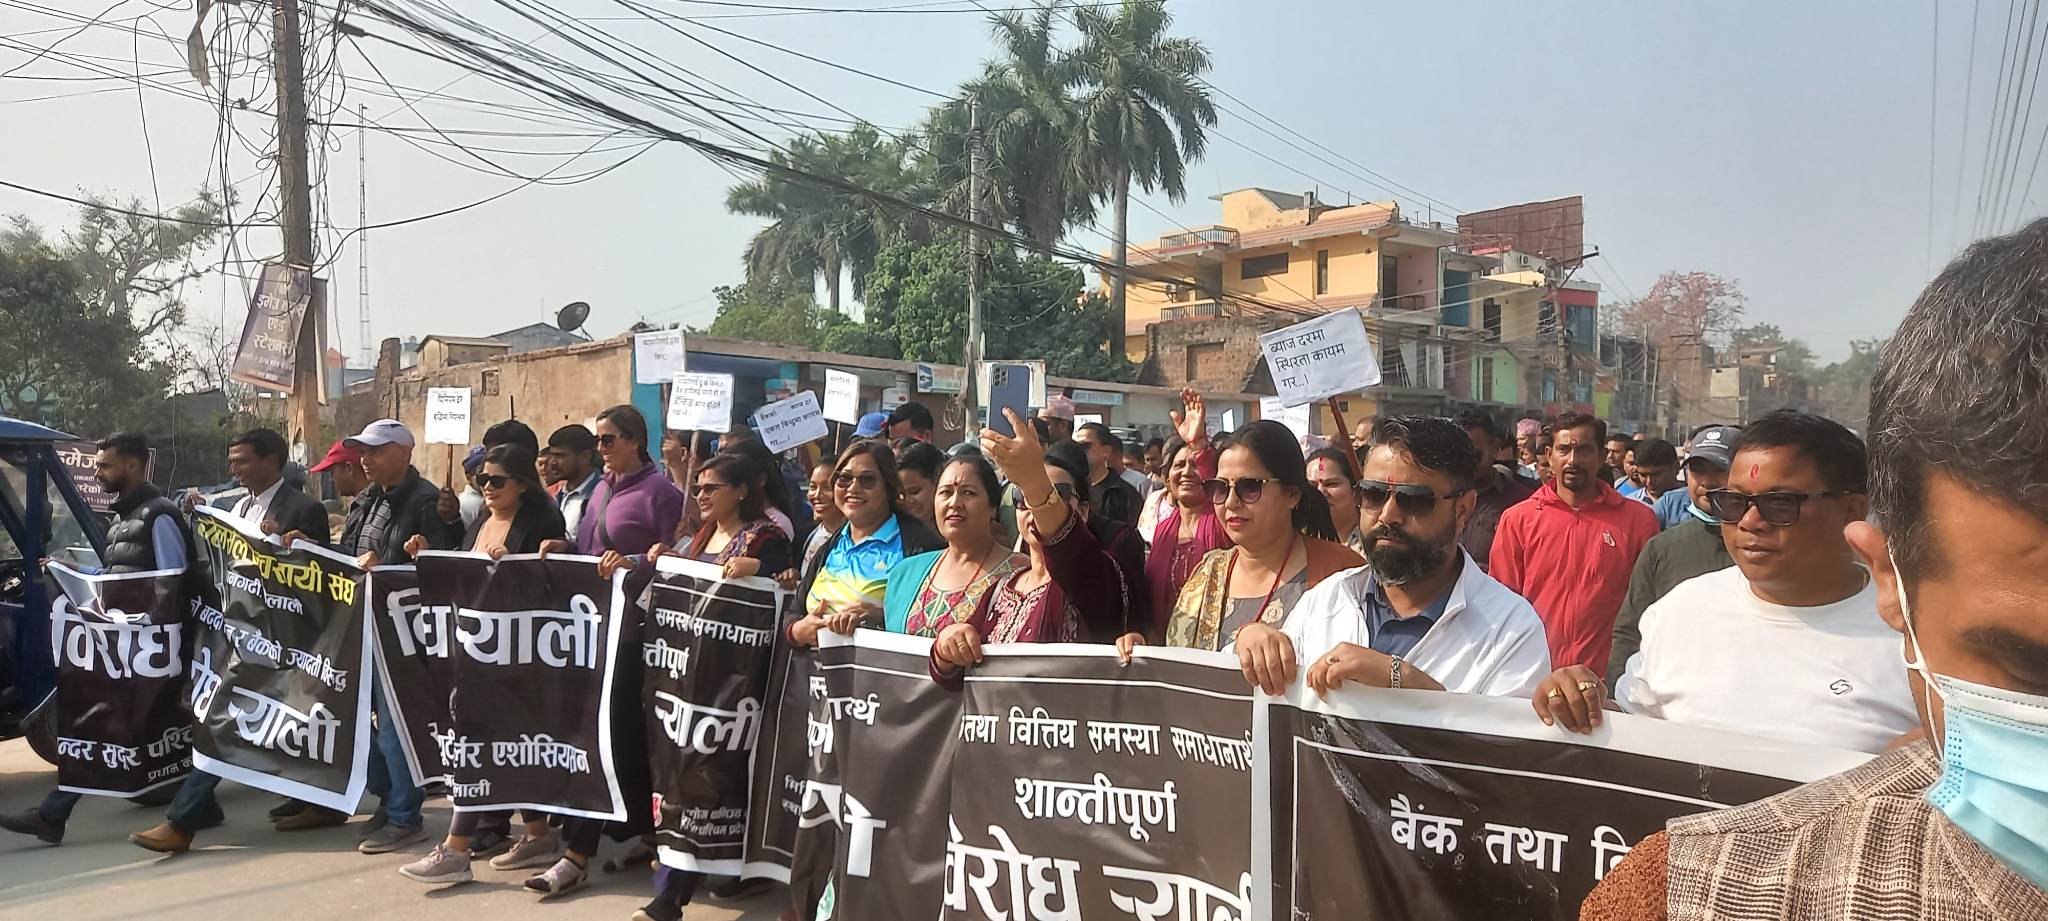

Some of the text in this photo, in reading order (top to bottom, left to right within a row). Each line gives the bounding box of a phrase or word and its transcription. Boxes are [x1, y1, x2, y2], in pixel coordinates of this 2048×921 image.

[1275, 343, 1346, 373] स्थिरता कायम
[1297, 328, 1325, 347] दरमा
[328, 572, 356, 606] संघ
[963, 714, 999, 744] तथा
[1008, 706, 1078, 750] वित्तिय
[1087, 719, 1161, 757] समस्या
[1014, 772, 1178, 843] शान्तीपूर्ण
[1390, 793, 1464, 856] बैंक
[1484, 822, 1569, 874] तथा
